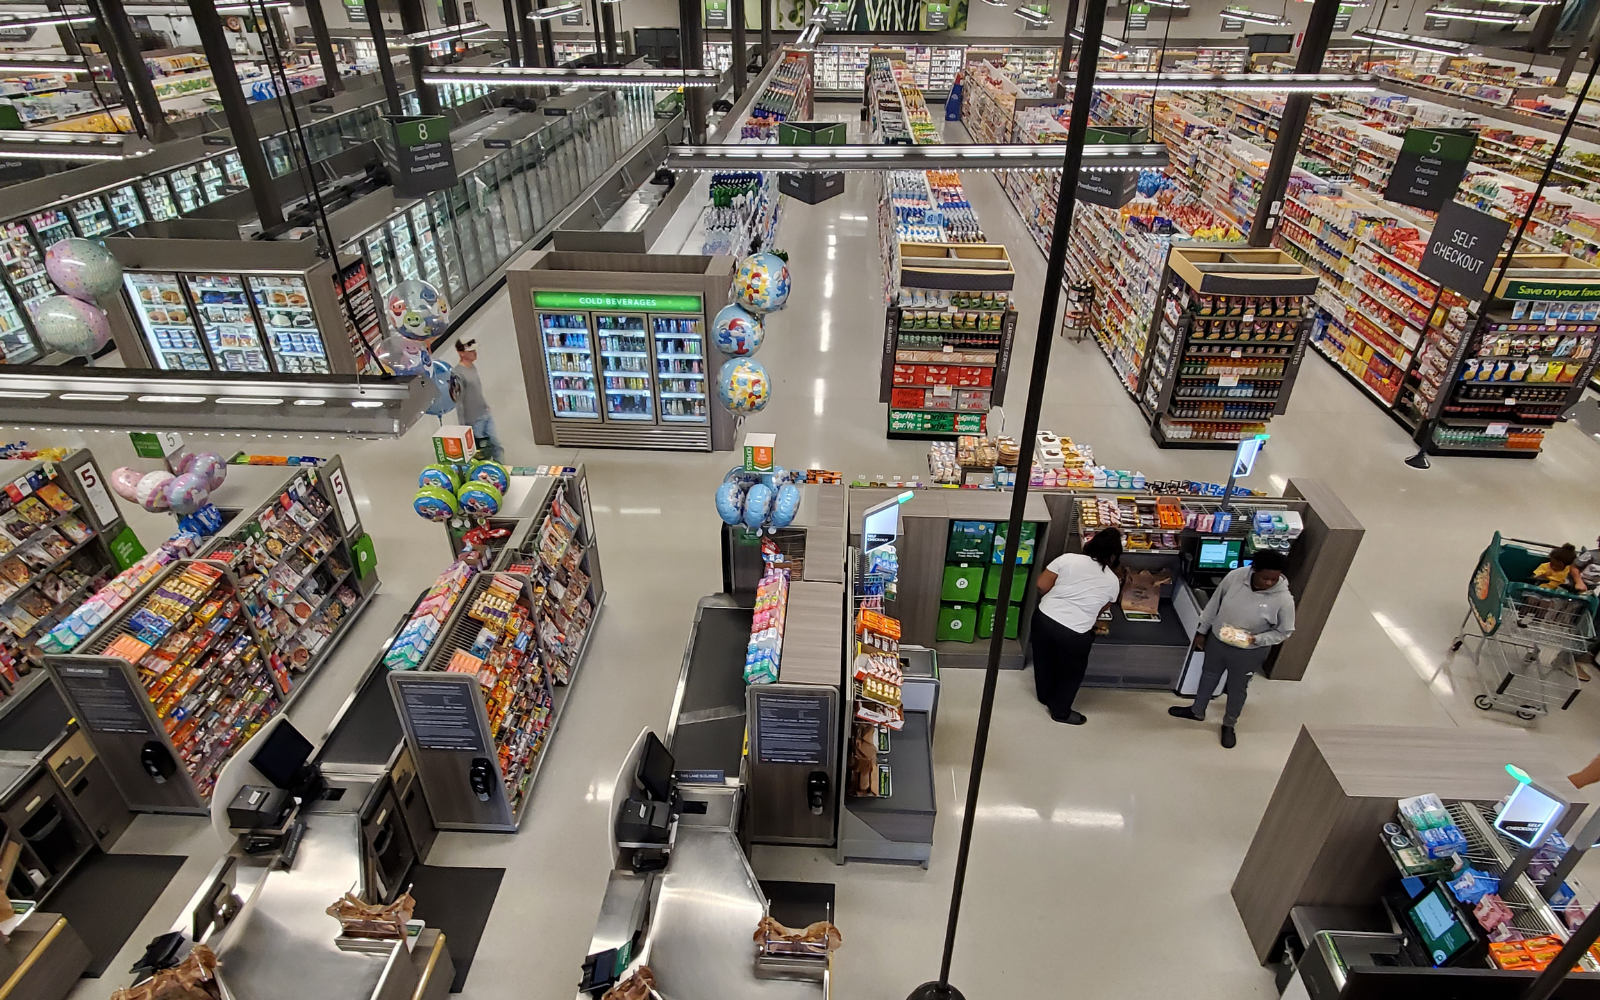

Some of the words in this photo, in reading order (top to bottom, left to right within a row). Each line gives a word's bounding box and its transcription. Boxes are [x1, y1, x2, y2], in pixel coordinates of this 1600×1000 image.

[418, 123, 428, 140] 8
[791, 129, 798, 144] 7
[828, 129, 835, 144] 7
[1429, 135, 1445, 154] 5
[1420, 155, 1441, 166] Cookies
[1090, 174, 1101, 182] Juice
[1414, 165, 1439, 176] Crackers
[1077, 181, 1098, 192] Powdered
[1098, 186, 1112, 196] Drinks
[1416, 177, 1430, 186] Nuts
[1409, 186, 1428, 197] Snacks
[1451, 229, 1479, 249] SELF
[1432, 241, 1485, 274] CHECKOUT
[1517, 285, 1542, 295] Save
[1556, 289, 1580, 298] your
[579, 297, 603, 305] COLD
[605, 298, 657, 307] BEVERAGES
[892, 411, 916, 420] Sprite
[892, 421, 916, 430] Sprite
[166, 432, 176, 447] 5
[435, 437, 445, 462] EXPRESS
[80, 468, 96, 489] 5
[333, 475, 343, 495] 5
